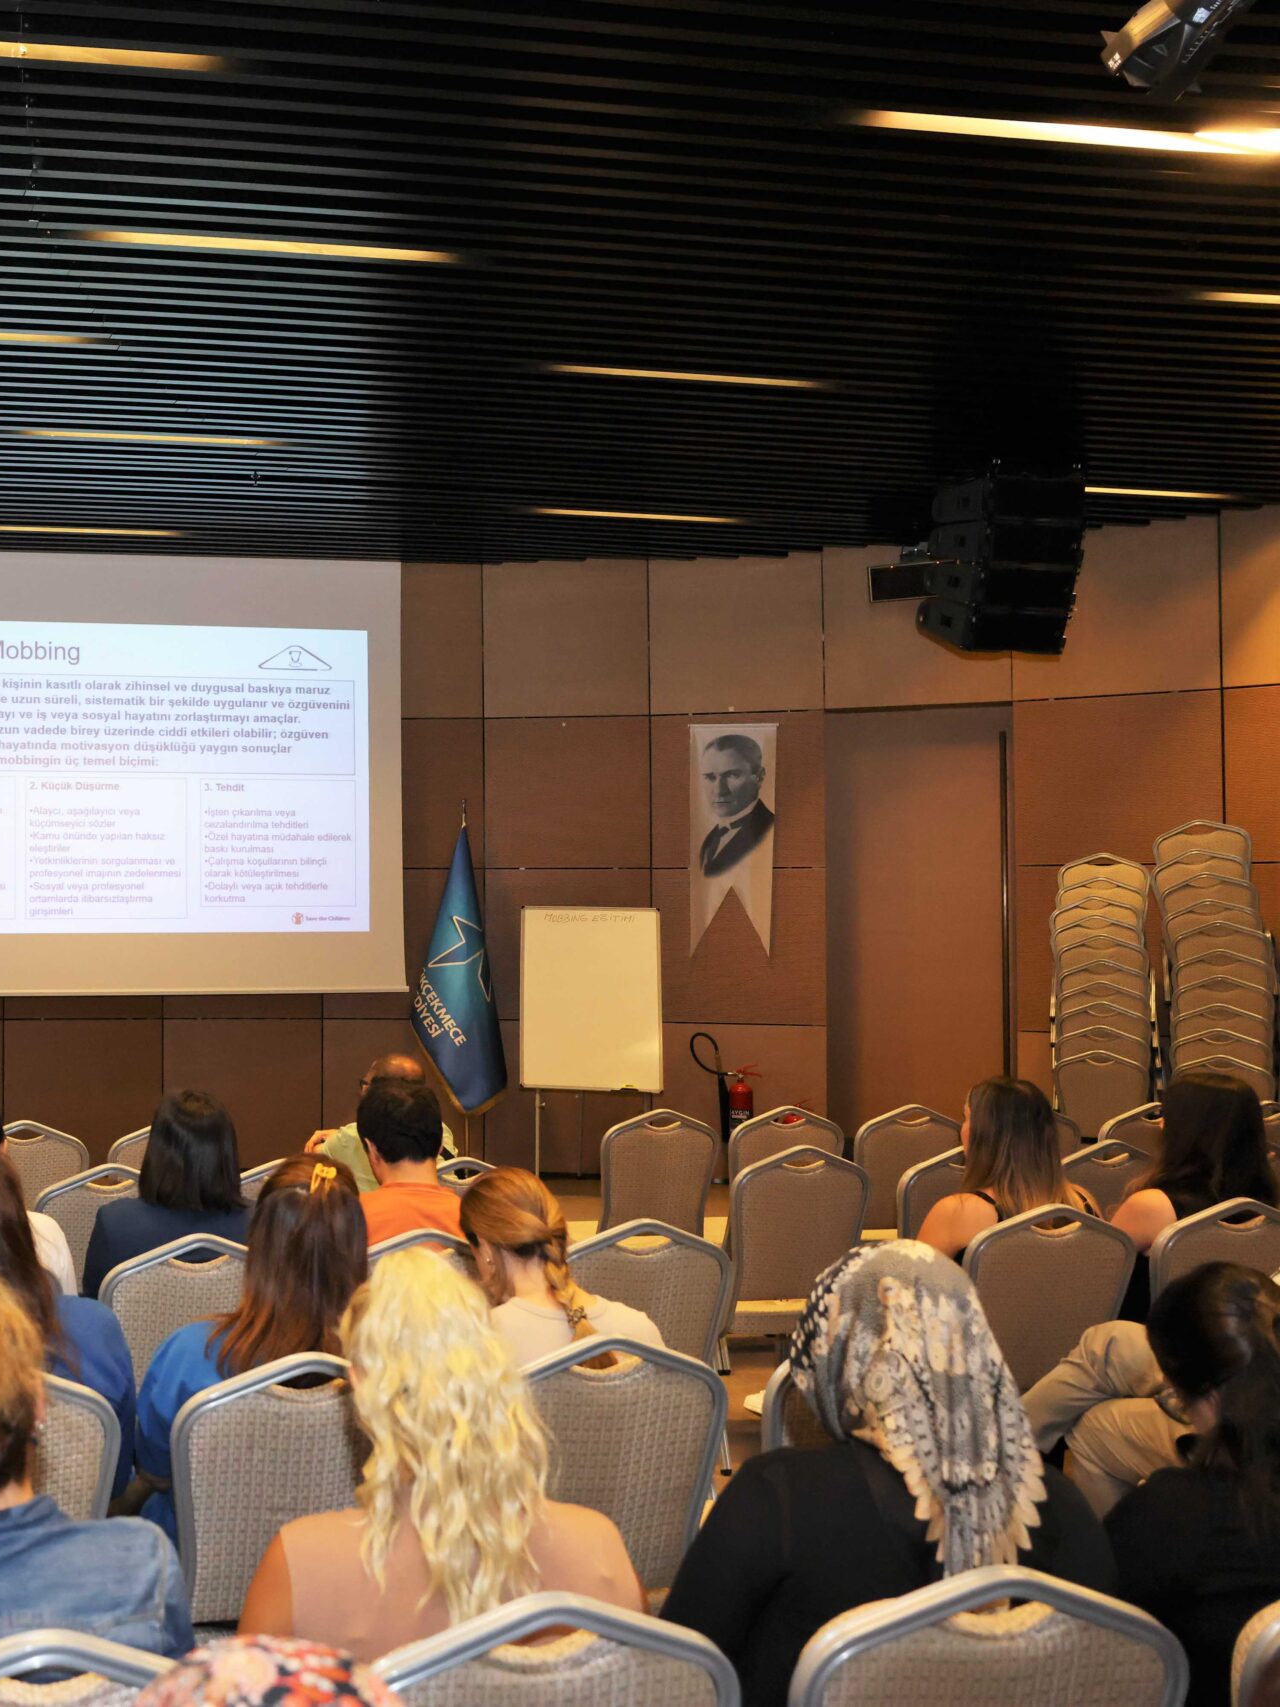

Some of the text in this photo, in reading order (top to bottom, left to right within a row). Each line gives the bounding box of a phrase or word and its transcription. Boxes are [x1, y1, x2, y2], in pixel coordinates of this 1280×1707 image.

[2, 679, 42, 690] kişinin
[46, 680, 81, 690] kasıtlı
[85, 681, 121, 690] olarak
[125, 681, 170, 692] zihinsel
[175, 683, 187, 692] ve
[191, 683, 244, 695] duygusal
[248, 684, 291, 695] baskıya
[295, 686, 331, 694] maruz
[12, 695, 40, 704] uzun
[44, 695, 81, 706] süreli,
[85, 695, 145, 706] sistematik
[149, 697, 164, 706] bir
[168, 697, 209, 709] şekilde
[213, 698, 267, 709] uygulanır
[271, 700, 284, 709] ve
[288, 700, 350, 710] özgüvenini
[19, 711, 32, 719] ve
[36, 710, 46, 721] iş
[51, 711, 78, 721] veya
[82, 711, 120, 722] sosyal
[125, 711, 171, 722] hayatını
[175, 713, 249, 724] zorlaştırmayı
[253, 714, 301, 725] amaçlar.
[23, 725, 67, 735] vadede
[71, 726, 99, 737] birey
[104, 727, 154, 737] üzerinde
[158, 727, 187, 737] ciddi
[191, 728, 230, 738] etkileri
[233, 729, 277, 739] olabilir;
[280, 730, 328, 741] özgüven
[61, 741, 129, 752] motivasyon
[134, 742, 196, 753] düşüklüğü
[200, 744, 238, 754] yaygın
[242, 744, 292, 755] sonuçlar
[65, 756, 78, 767] üç
[83, 756, 115, 766] temel
[119, 756, 159, 767] biçimi:
[30, 782, 119, 791] 2. Küçük Düşürme
[216, 784, 244, 792] Tehdit
[275, 809, 295, 818] veya
[272, 821, 308, 829] tehditleri
[208, 832, 351, 843] Özel hayatına müdahale edilerek
[208, 857, 326, 867] Çalışma koşullarının bilinçli
[205, 870, 231, 878] olarak
[209, 882, 328, 892] Dolaylı veya açık tehditlerle
[205, 895, 245, 903] korkutma
